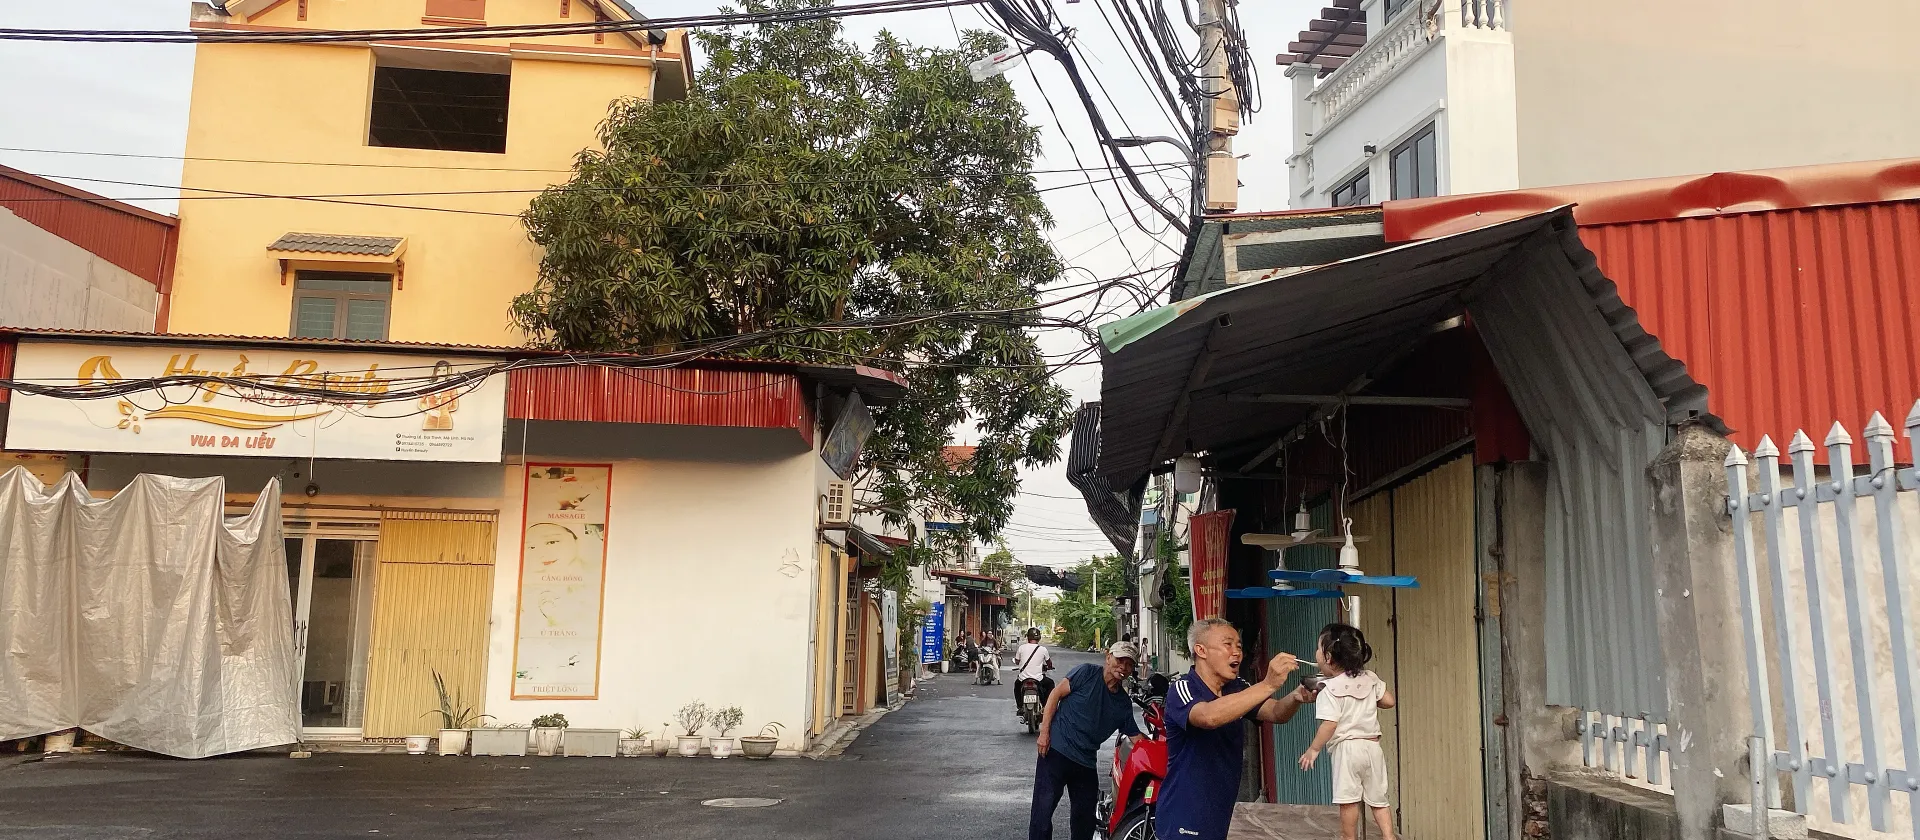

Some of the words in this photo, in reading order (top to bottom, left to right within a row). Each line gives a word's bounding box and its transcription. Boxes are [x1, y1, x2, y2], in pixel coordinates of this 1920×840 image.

[190, 434, 216, 447] VUA
[221, 435, 240, 448] DA
[245, 431, 276, 449] LIỄU
